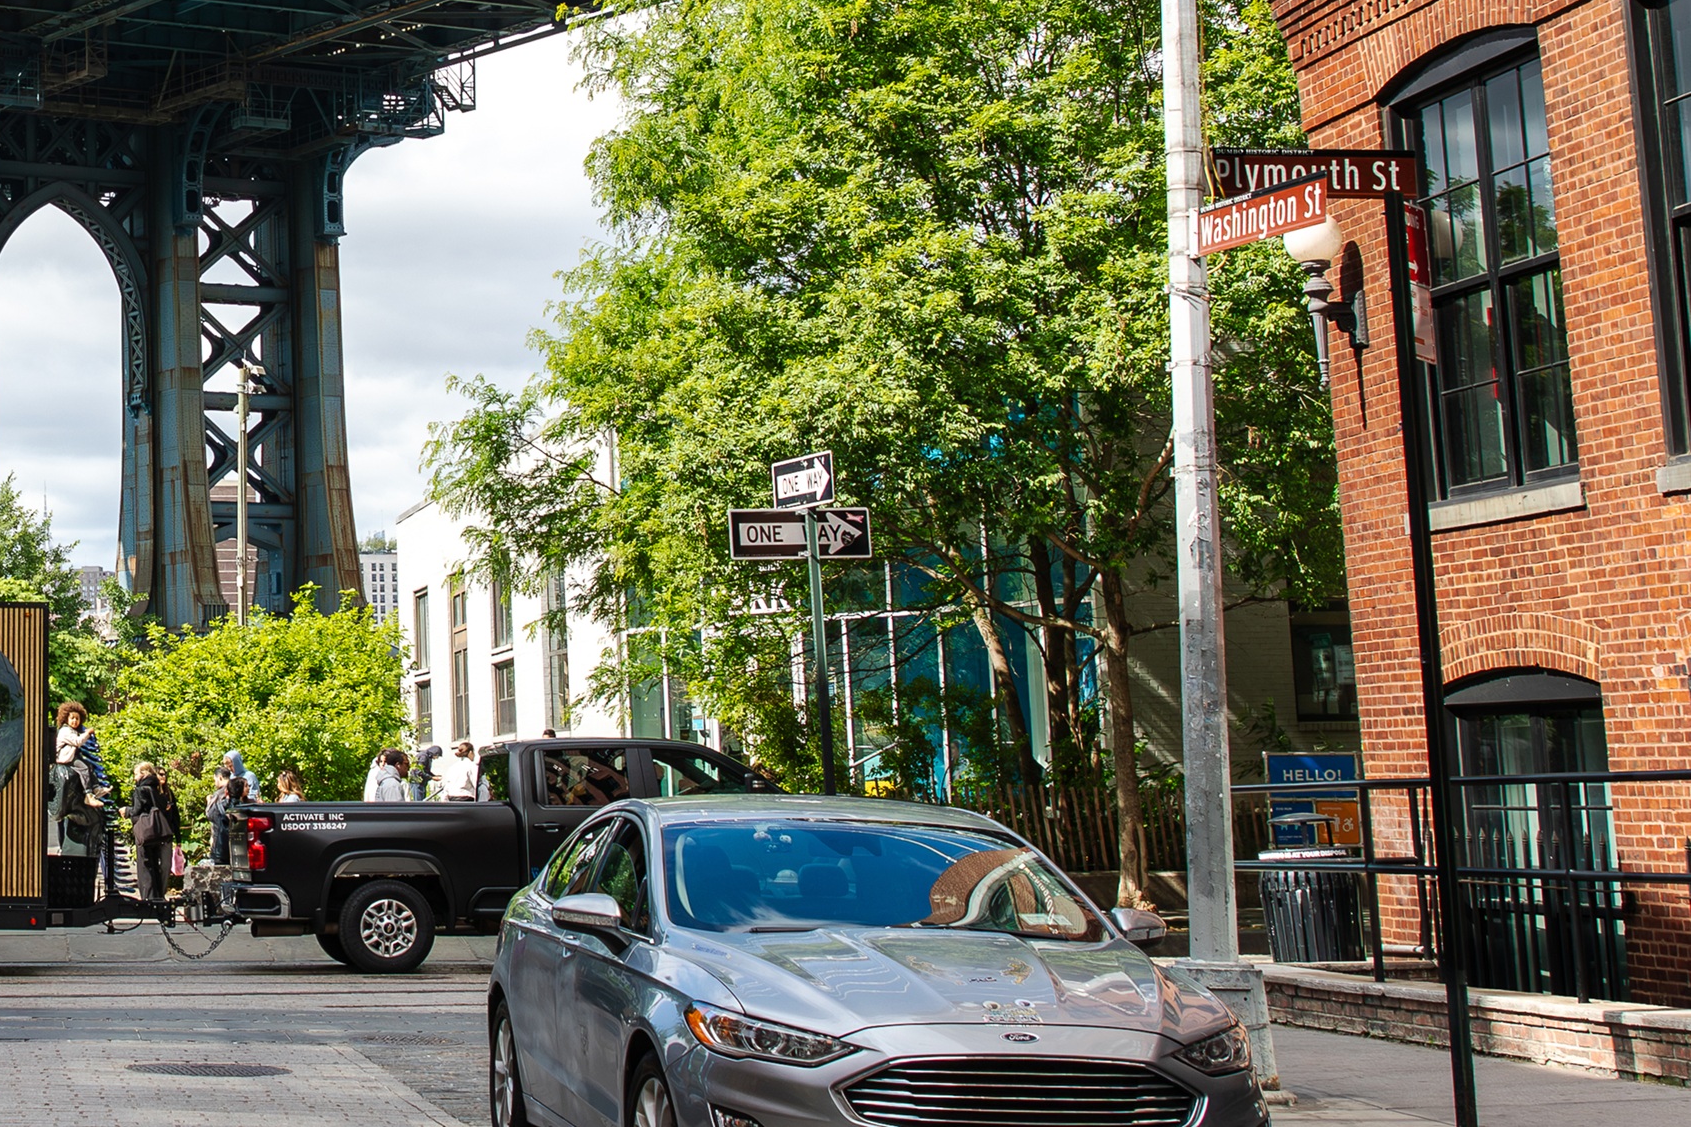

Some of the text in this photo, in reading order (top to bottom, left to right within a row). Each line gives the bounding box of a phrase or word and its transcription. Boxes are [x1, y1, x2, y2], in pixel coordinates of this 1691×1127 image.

[1245, 148, 1280, 156] HISTORIC
[1372, 160, 1401, 191] St
[1200, 182, 1322, 247] Washington St
[783, 470, 824, 495] ONE WAY
[746, 525, 784, 543] ONE
[1282, 769, 1342, 781] HELLO!
[282, 813, 345, 821] ACTIVATE INC
[281, 822, 347, 831] USDOT 3136247
